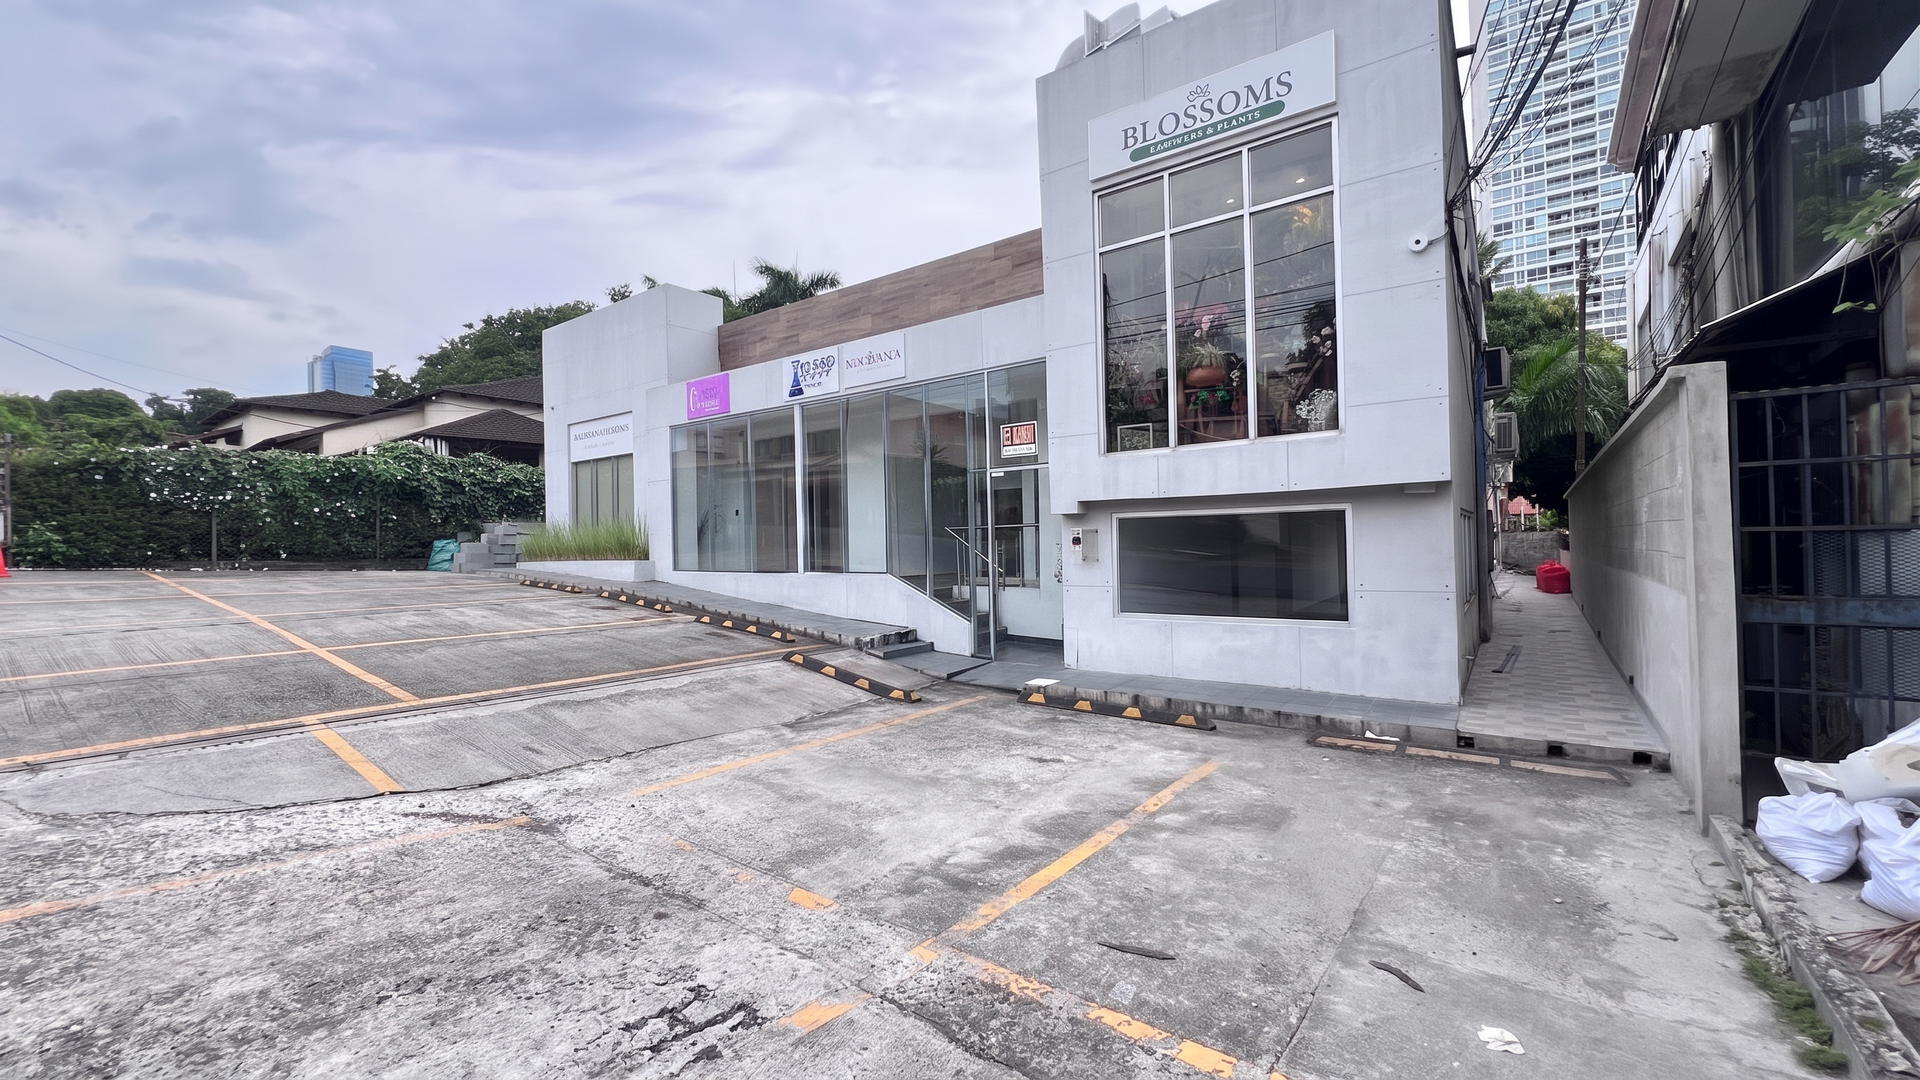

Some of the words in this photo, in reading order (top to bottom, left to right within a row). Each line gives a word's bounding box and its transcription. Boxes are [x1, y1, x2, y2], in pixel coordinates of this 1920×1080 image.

[1121, 70, 1293, 151] BLOSSOMS
[1206, 126, 1214, 135] &
[1217, 110, 1261, 131] PLANTS
